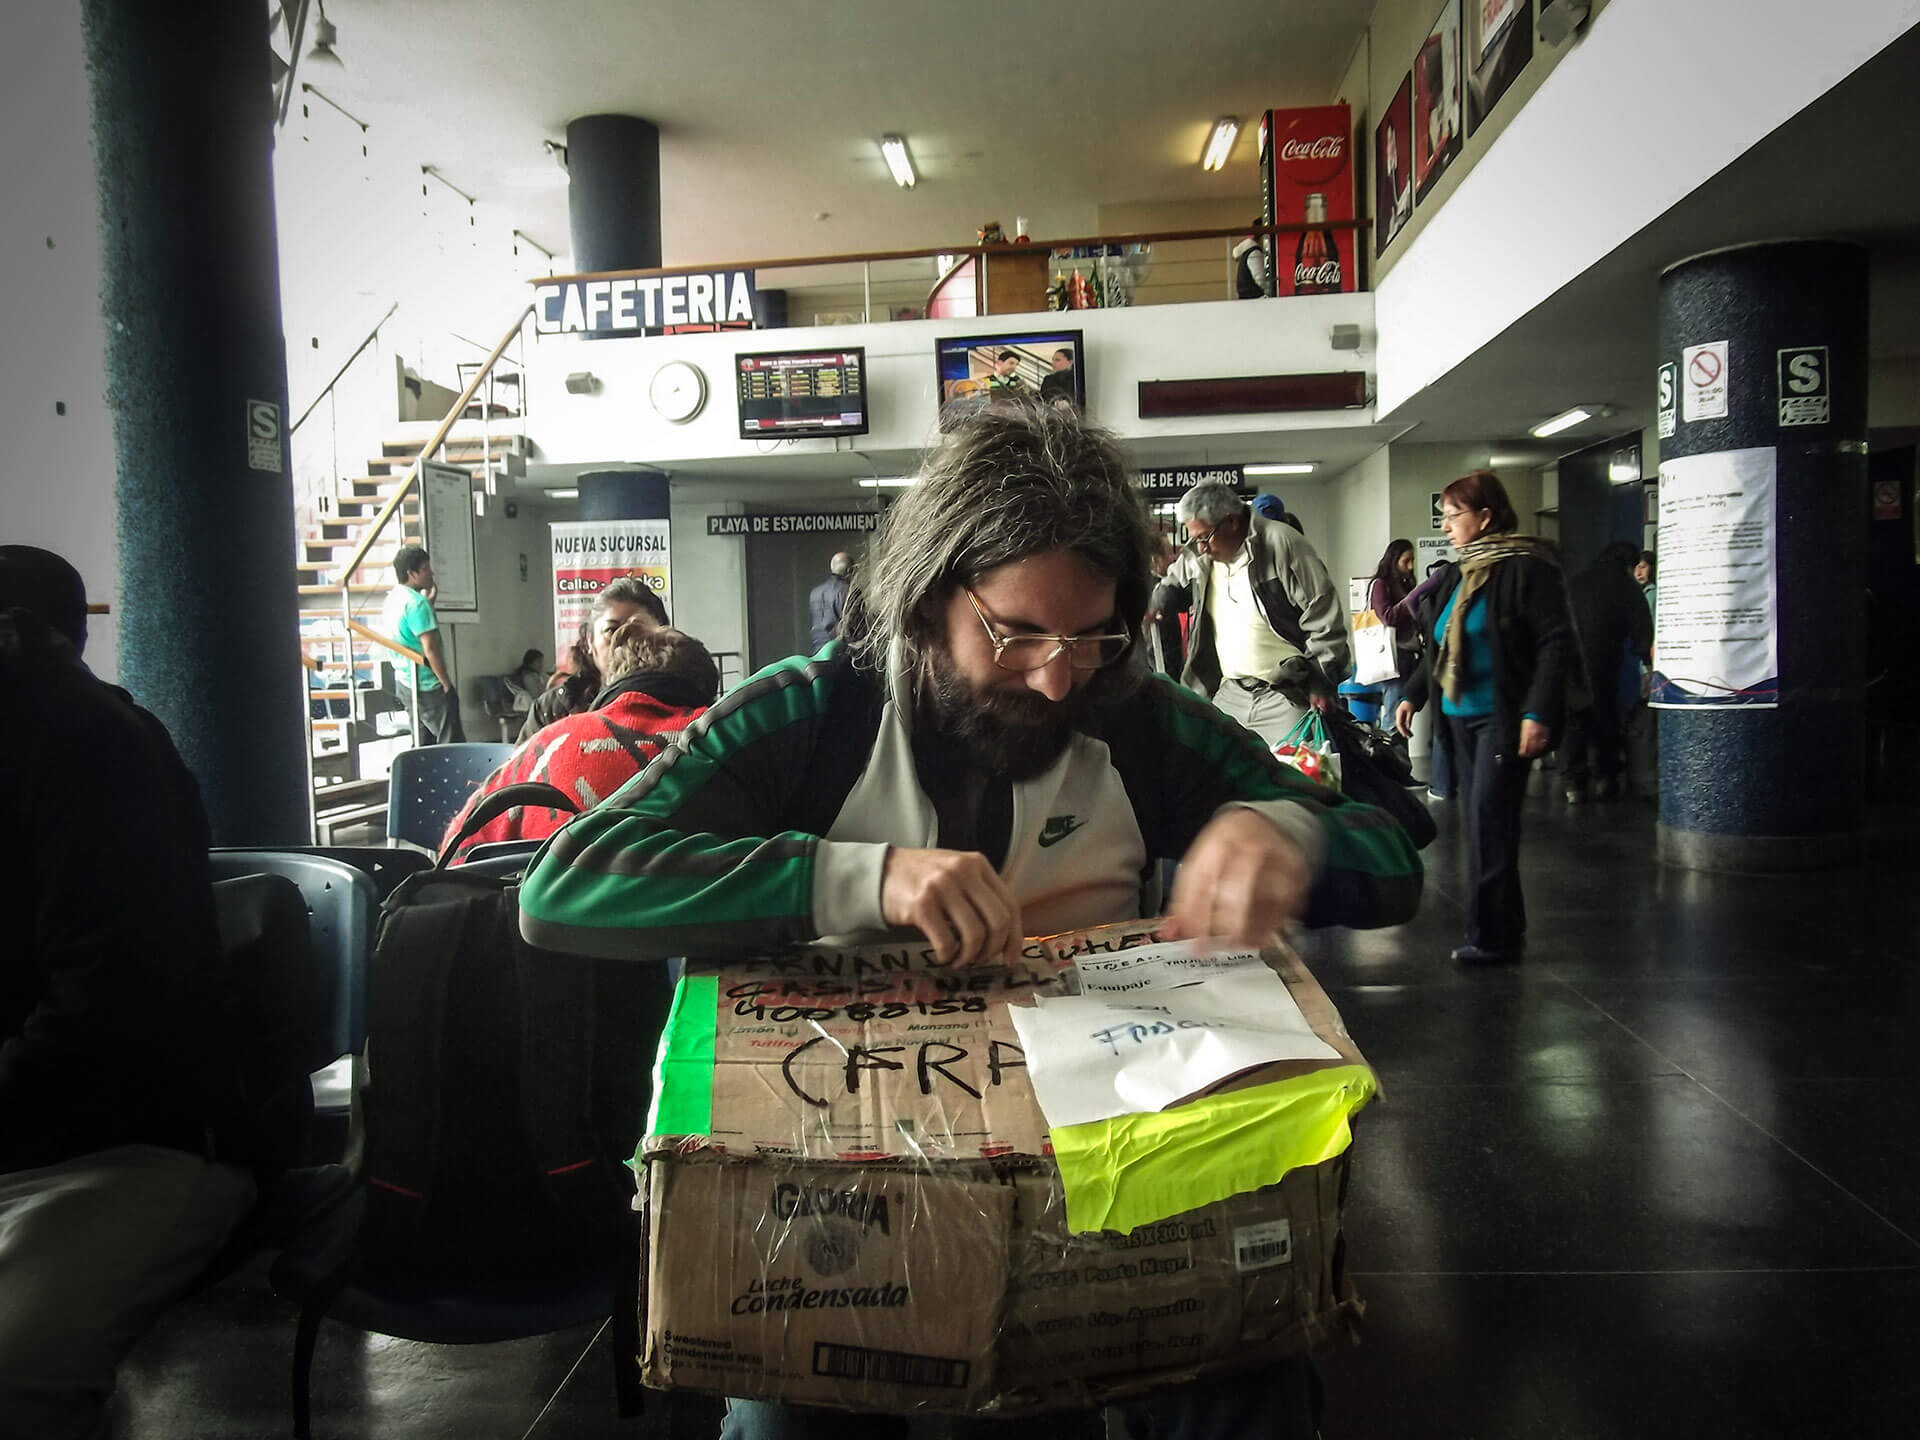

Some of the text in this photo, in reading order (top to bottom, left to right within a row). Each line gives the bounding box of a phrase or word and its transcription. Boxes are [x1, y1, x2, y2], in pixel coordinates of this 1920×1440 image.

[535, 271, 753, 333] CAFETERIA
[1788, 354, 1821, 393] S
[252, 405, 277, 439] S
[1159, 471, 1174, 487] DE
[711, 517, 749, 533] PLAYA
[753, 516, 769, 532] DE
[555, 535, 666, 554] NUEVA SUCURSAL
[559, 577, 598, 592] Callao
[1087, 978, 1152, 993] Equipaje
[907, 1022, 970, 1032] Manzana
[772, 1182, 890, 1236] GLORIA
[749, 1276, 803, 1294] Leche
[731, 1281, 909, 1316] Condensada
